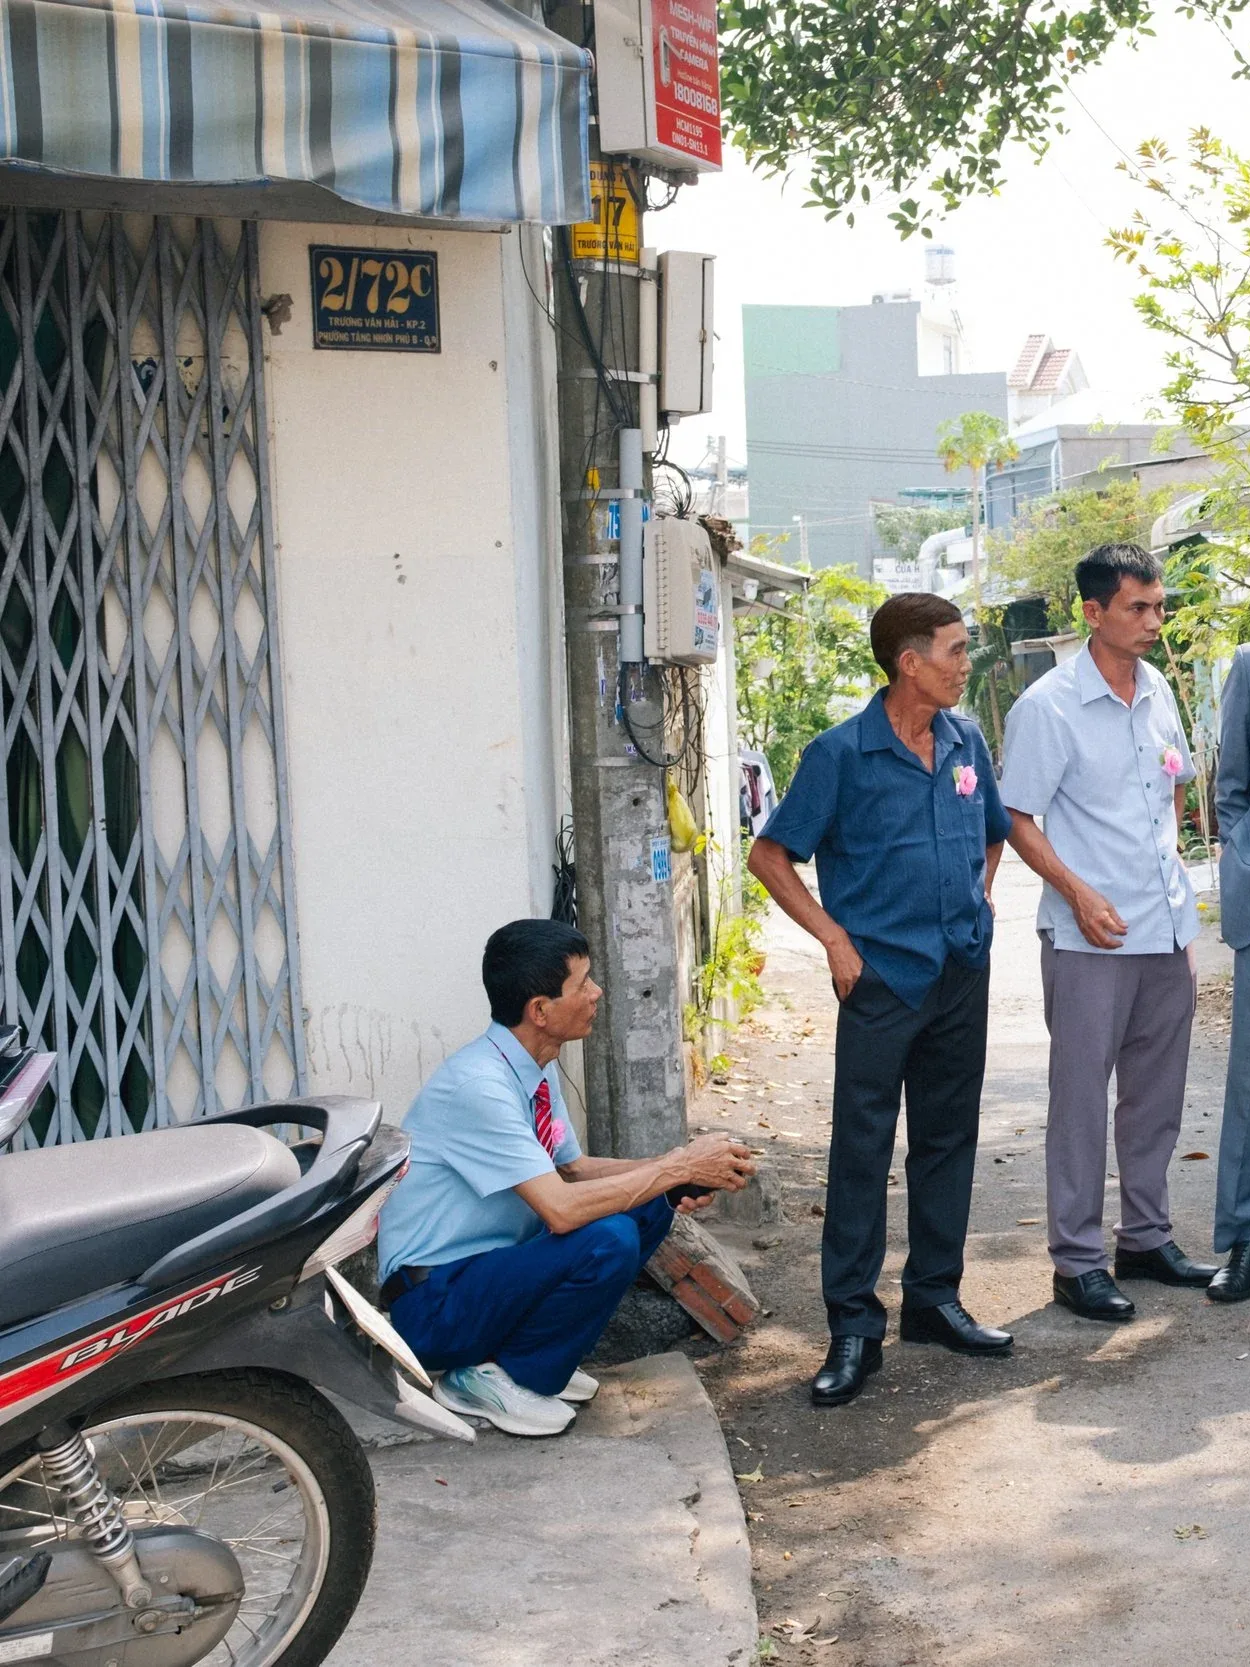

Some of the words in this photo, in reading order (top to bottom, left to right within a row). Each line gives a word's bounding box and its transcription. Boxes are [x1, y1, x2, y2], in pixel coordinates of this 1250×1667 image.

[679, 48, 709, 72] CAMERA
[673, 81, 718, 116] 18008168
[406, 320, 426, 330] KP.2
[60, 1265, 263, 1370] BLADE
